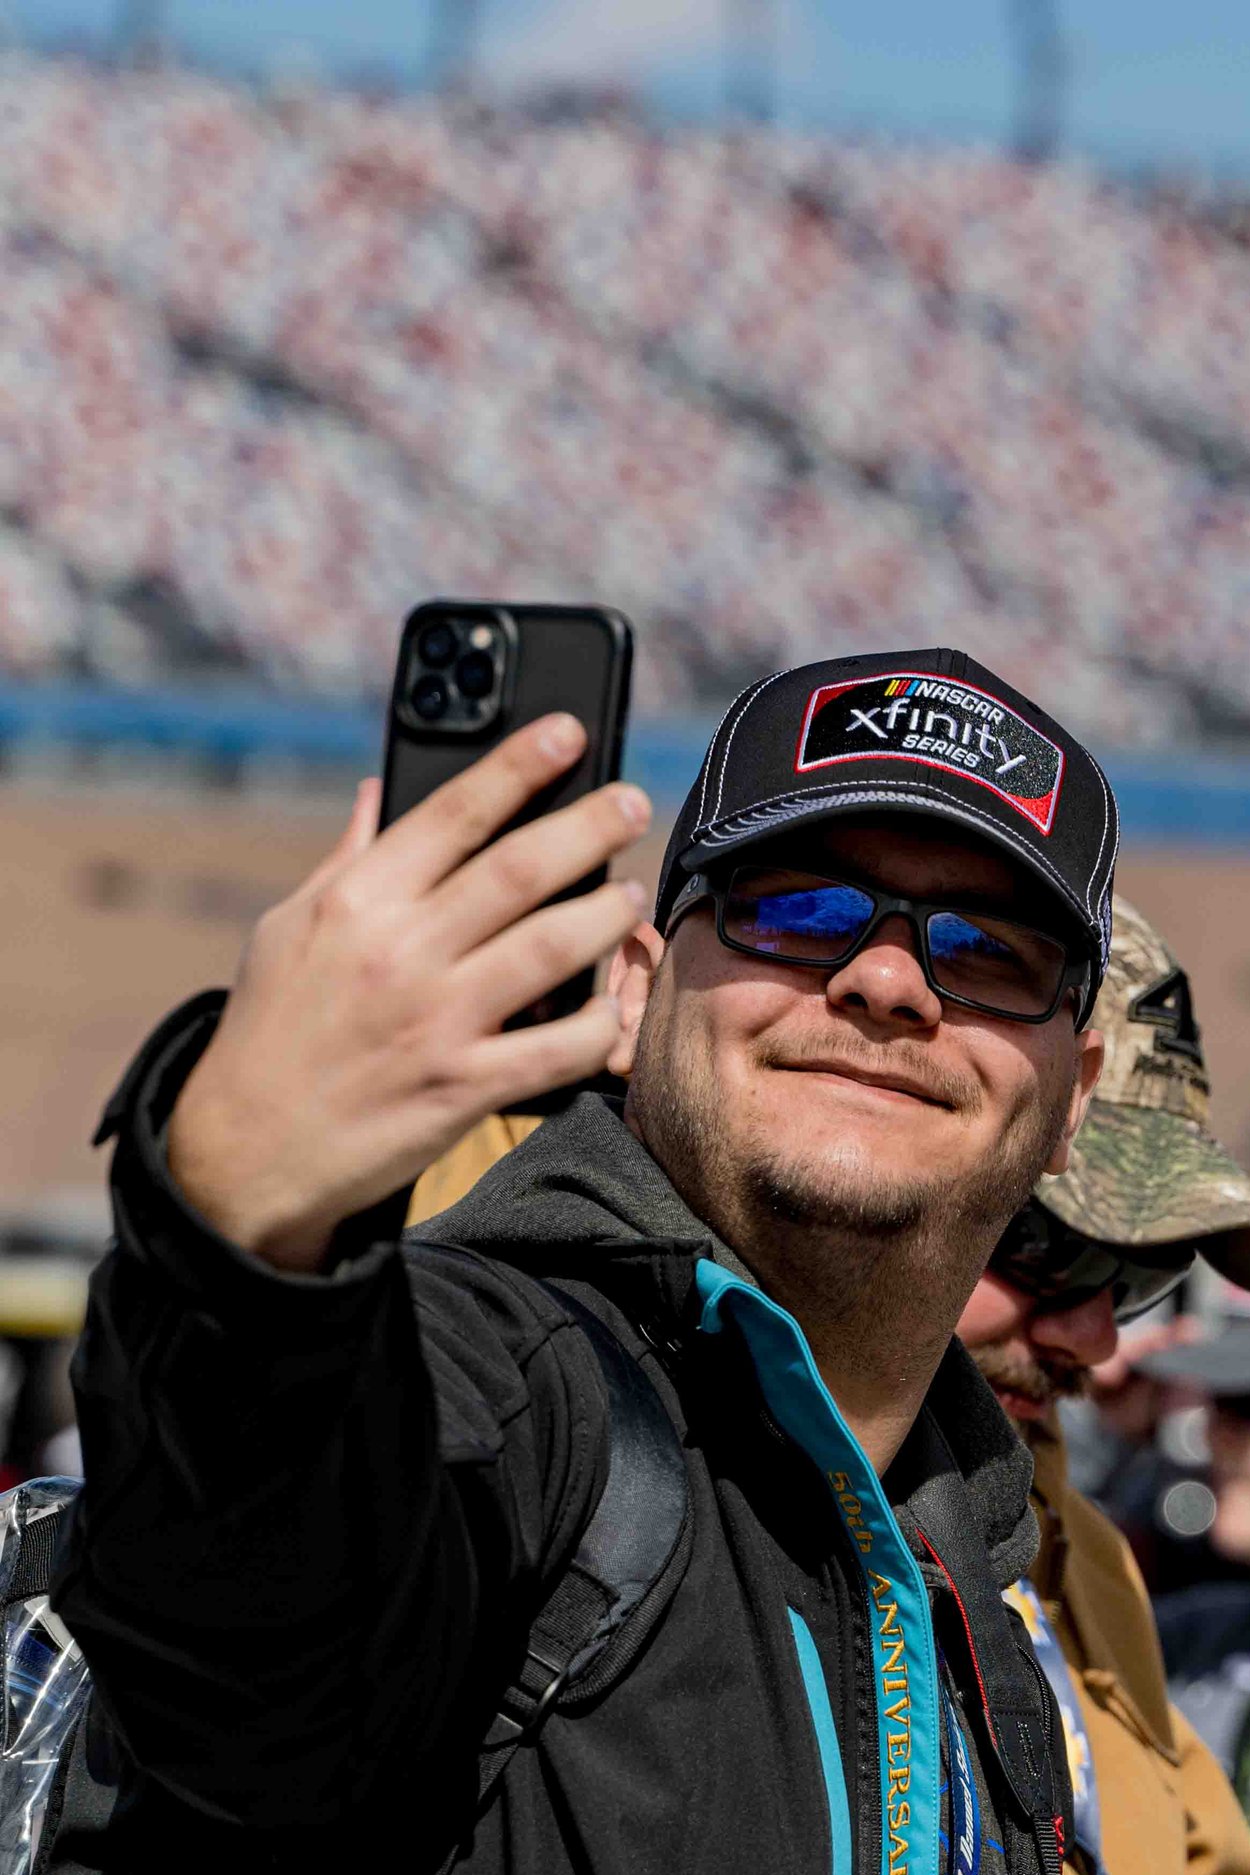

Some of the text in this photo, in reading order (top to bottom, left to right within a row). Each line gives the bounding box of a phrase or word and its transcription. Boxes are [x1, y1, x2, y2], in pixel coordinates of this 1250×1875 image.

[915, 680, 1006, 723] NASCAR
[845, 697, 1028, 776] xfinity
[902, 734, 981, 769] SERIES
